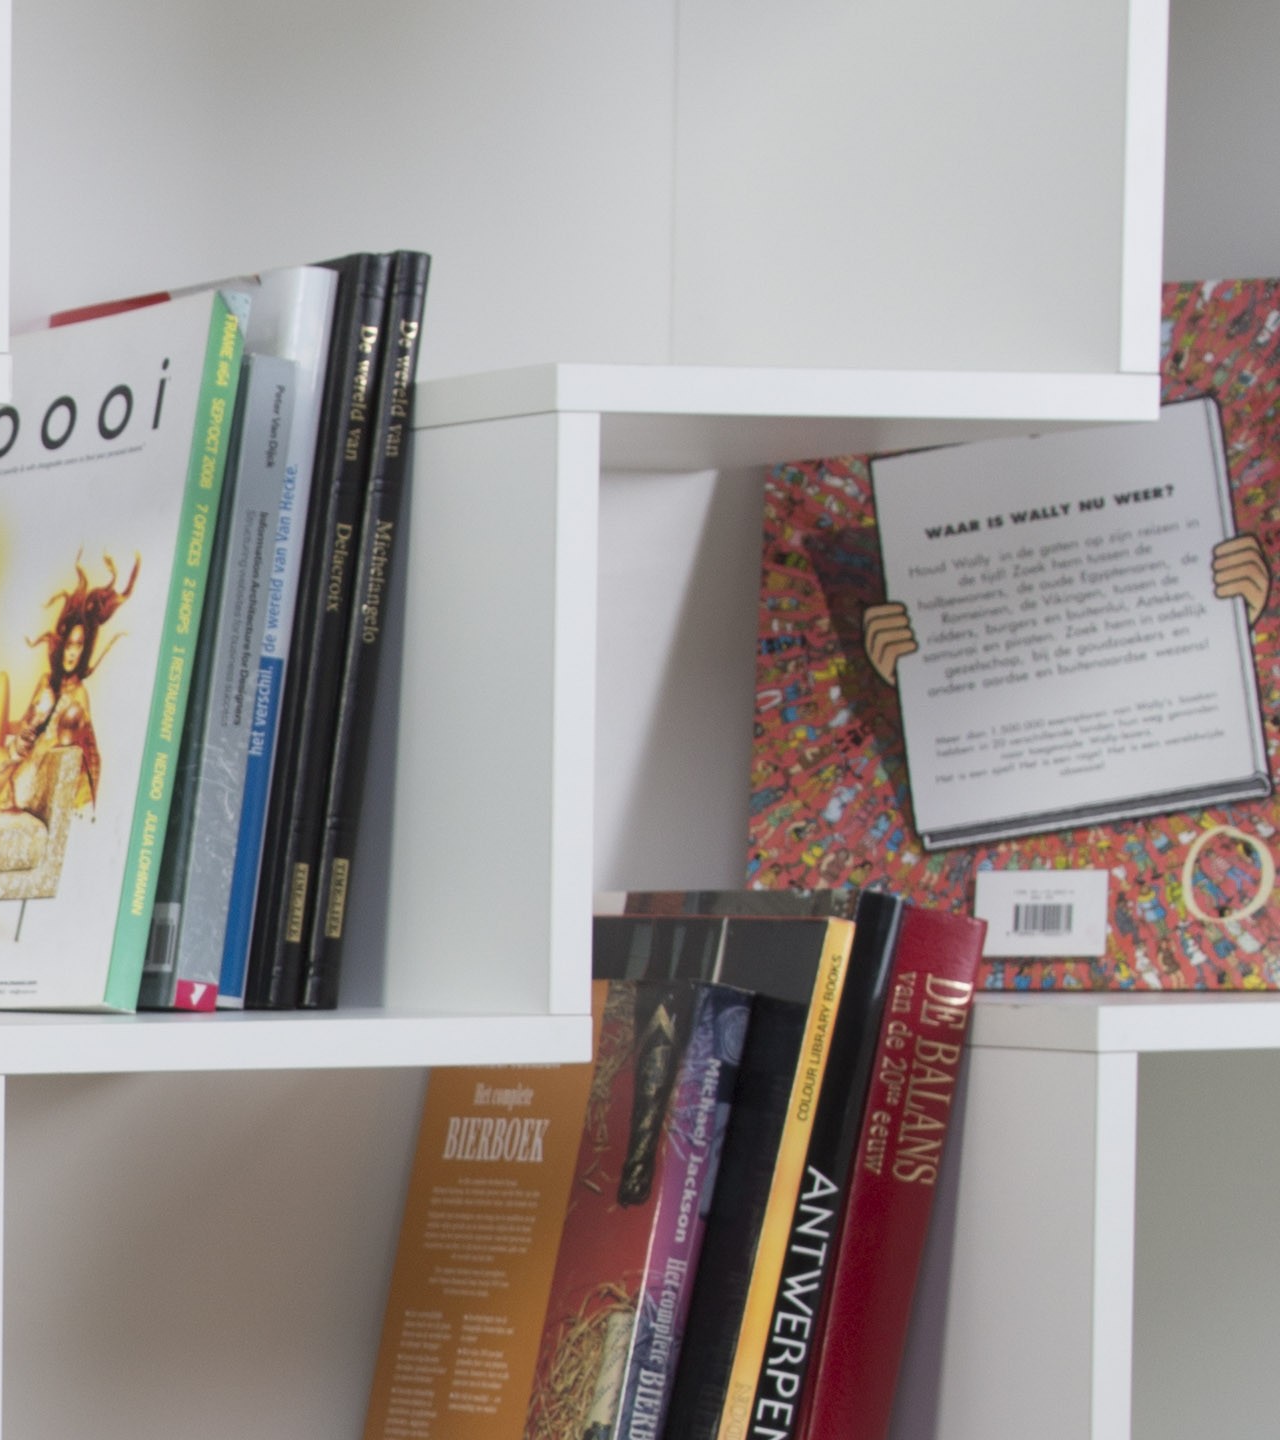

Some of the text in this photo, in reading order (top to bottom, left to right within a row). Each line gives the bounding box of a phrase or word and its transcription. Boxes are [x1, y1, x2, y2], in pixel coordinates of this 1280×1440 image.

[220, 313, 239, 360] FRAME
[205, 397, 226, 453] SEP/OCT
[326, 325, 378, 612] De wereld van Delacroix
[361, 320, 419, 645] De wereld van Michelangelo
[275, 511, 292, 542] Van
[925, 483, 1175, 540] WAAR IS WALLY NU WEER?
[187, 514, 208, 567] OFFICES
[272, 547, 286, 573] van
[176, 590, 196, 635] SHOPS
[266, 575, 284, 630] wereld
[265, 632, 277, 653] de
[160, 655, 186, 741] RESTAURANT
[249, 736, 263, 757] het
[148, 752, 169, 801] NENDO
[139, 810, 158, 847] JULIA
[891, 971, 917, 1014] van
[796, 953, 843, 1122] COLOUR LIBRARY BOOKS
[885, 1019, 913, 1051] de
[892, 972, 973, 1185] DE BALANS
[442, 1116, 550, 1163] BIERBOEK
[674, 1058, 723, 1244] Michael Jackson
[864, 1109, 892, 1176] eeuw
[666, 1256, 687, 1296] Het
